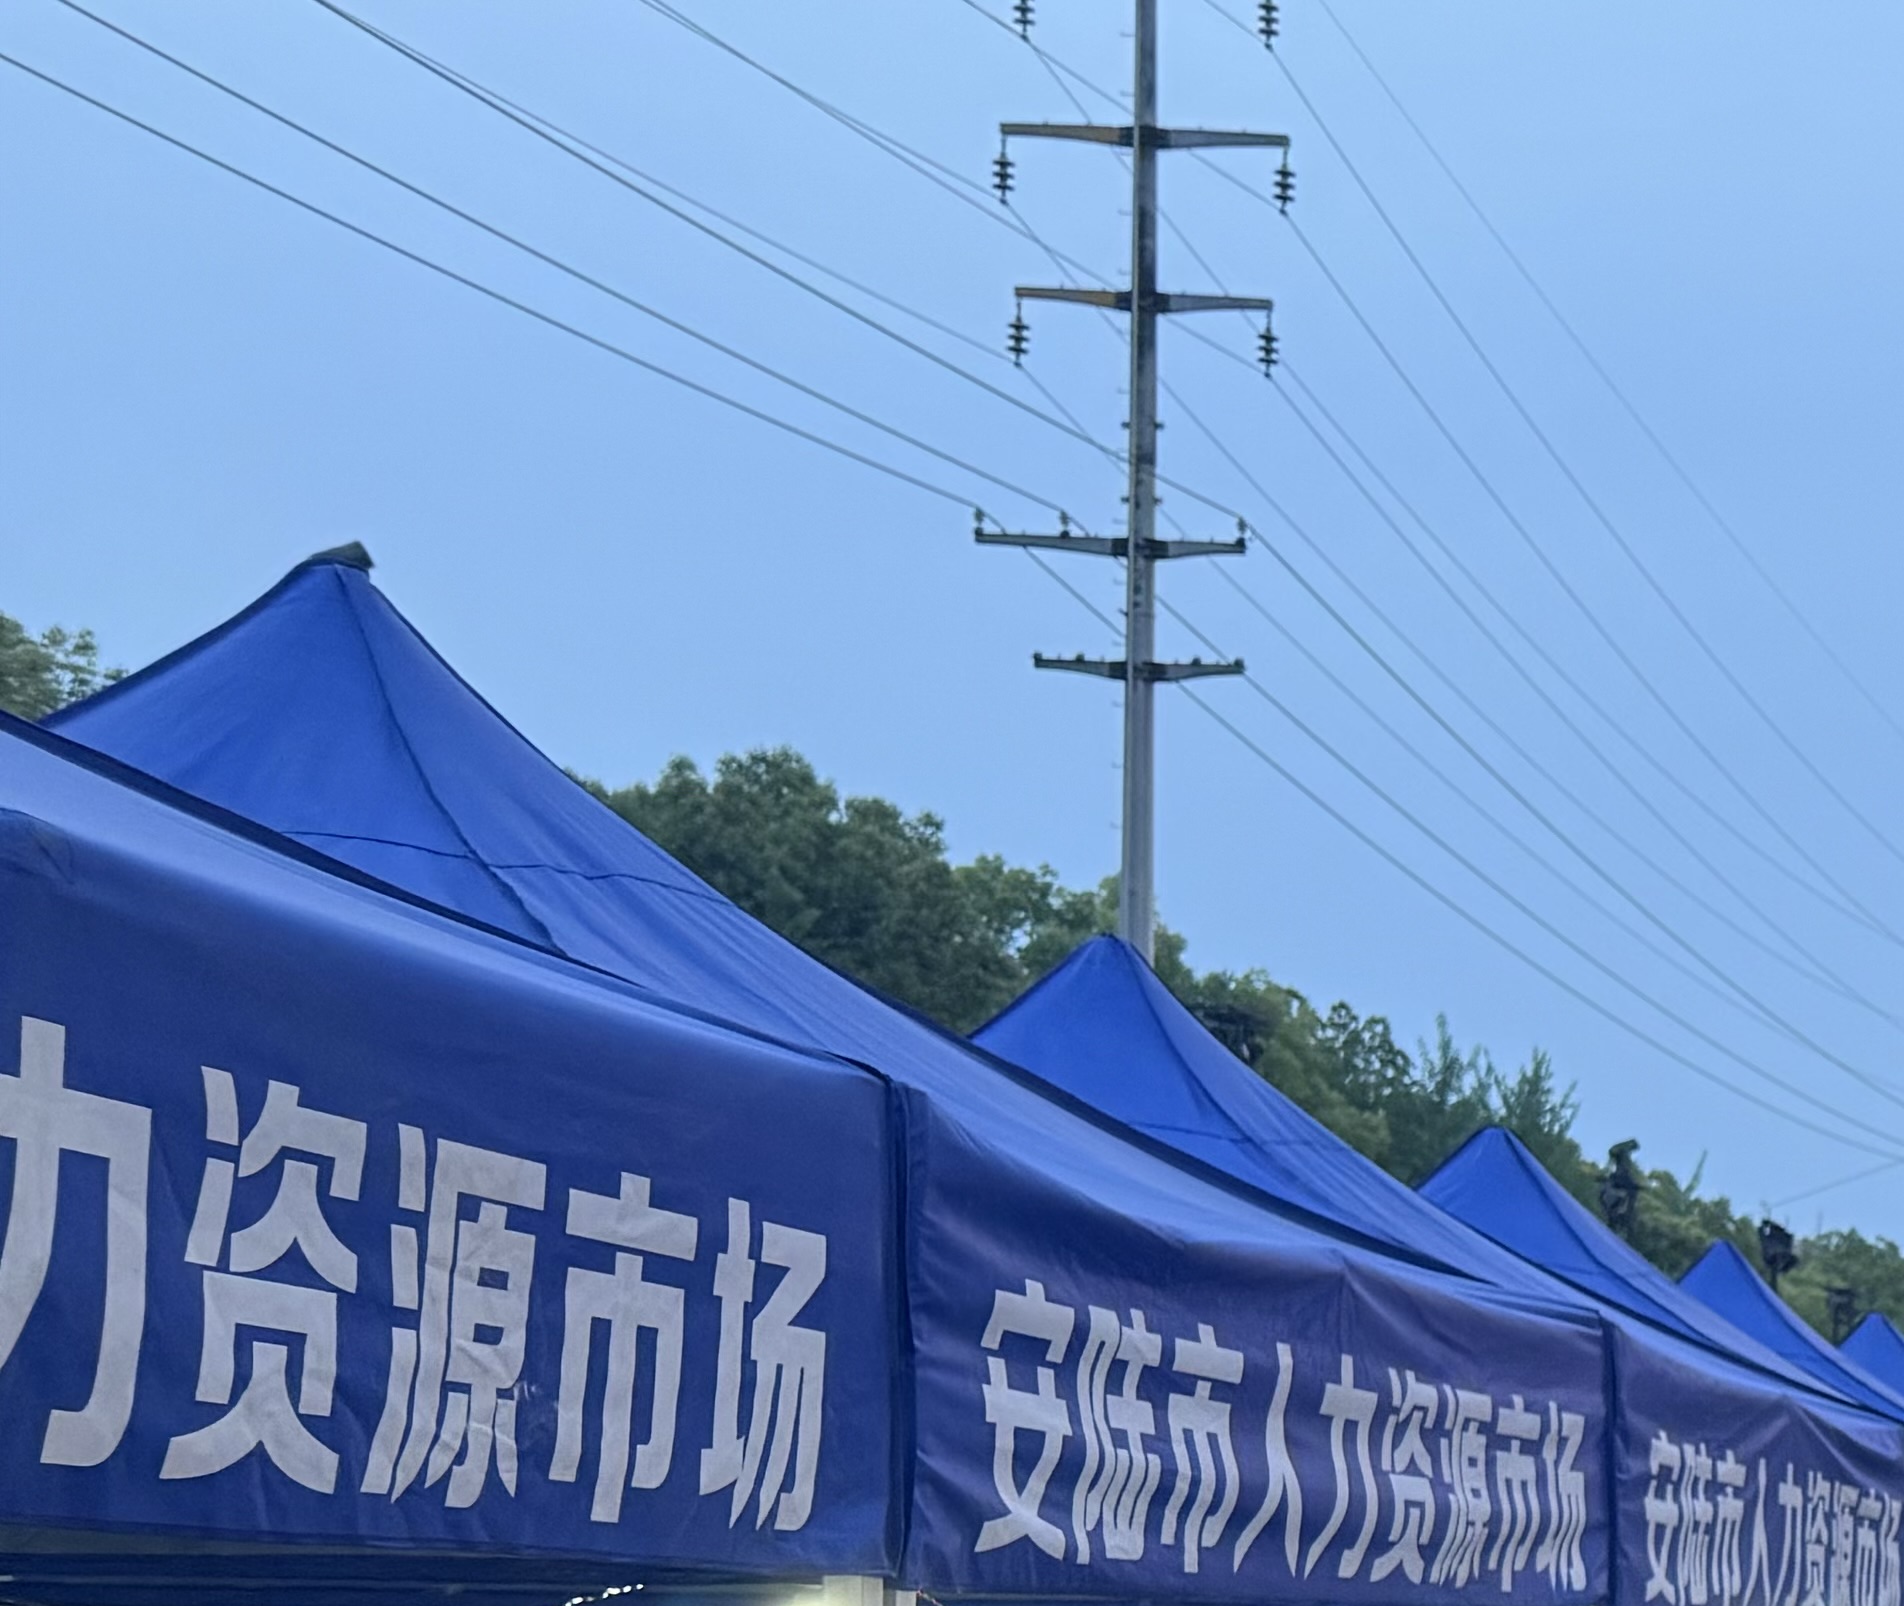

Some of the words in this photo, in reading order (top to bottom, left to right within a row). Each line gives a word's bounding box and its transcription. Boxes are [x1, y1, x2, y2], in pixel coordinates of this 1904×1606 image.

[0, 1016, 827, 1531] 力资源市场
[975, 1278, 1588, 1592] 安陆市人力资源市场
